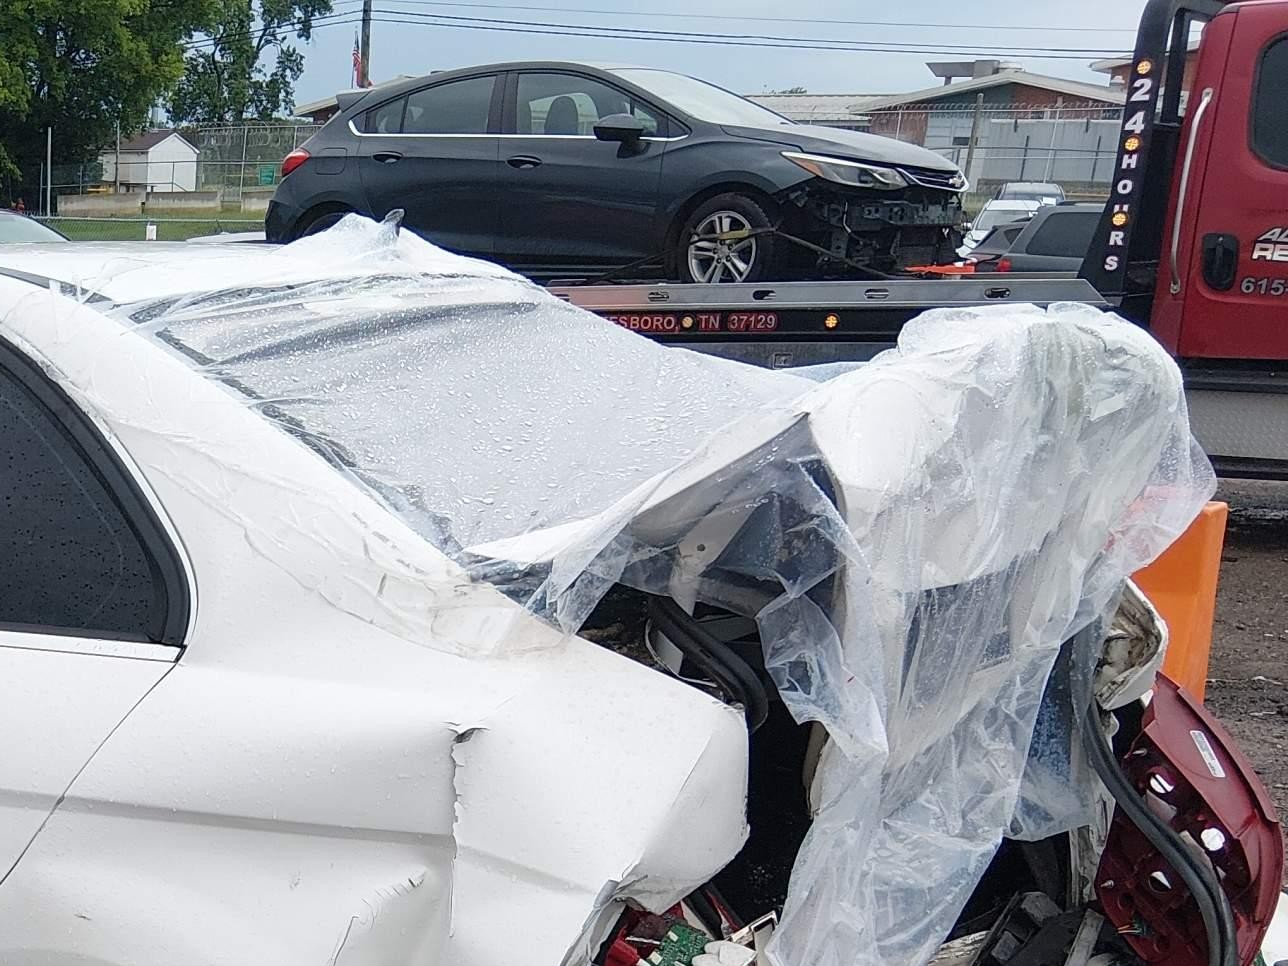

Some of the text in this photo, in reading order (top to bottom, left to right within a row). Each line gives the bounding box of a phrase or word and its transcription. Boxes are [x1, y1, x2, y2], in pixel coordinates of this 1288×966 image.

[1124, 78, 1152, 134] 24
[699, 315, 720, 329] TN
[730, 315, 776, 329] 37129
